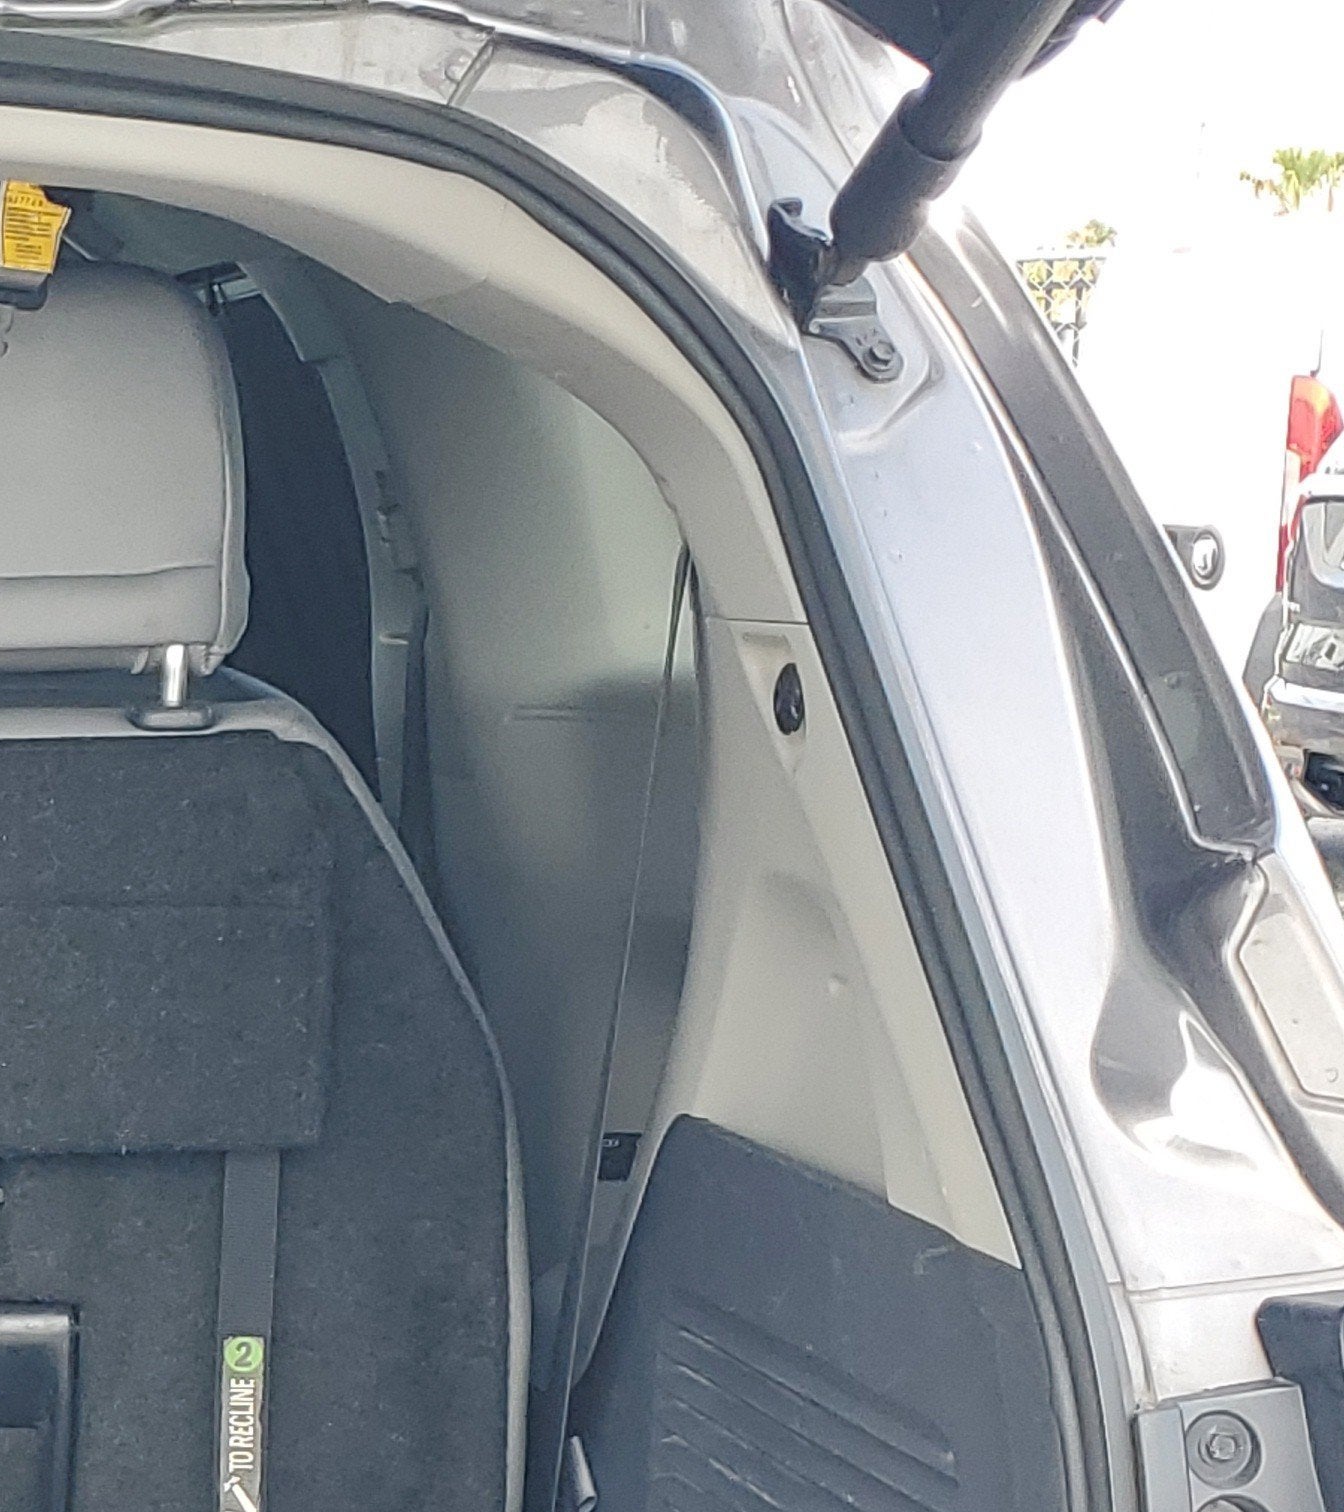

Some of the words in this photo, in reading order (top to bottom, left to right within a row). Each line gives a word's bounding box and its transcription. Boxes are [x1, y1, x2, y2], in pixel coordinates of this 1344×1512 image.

[234, 1341, 253, 1368] 2
[228, 1377, 256, 1449] RECLINE
[228, 1450, 254, 1473] TO
